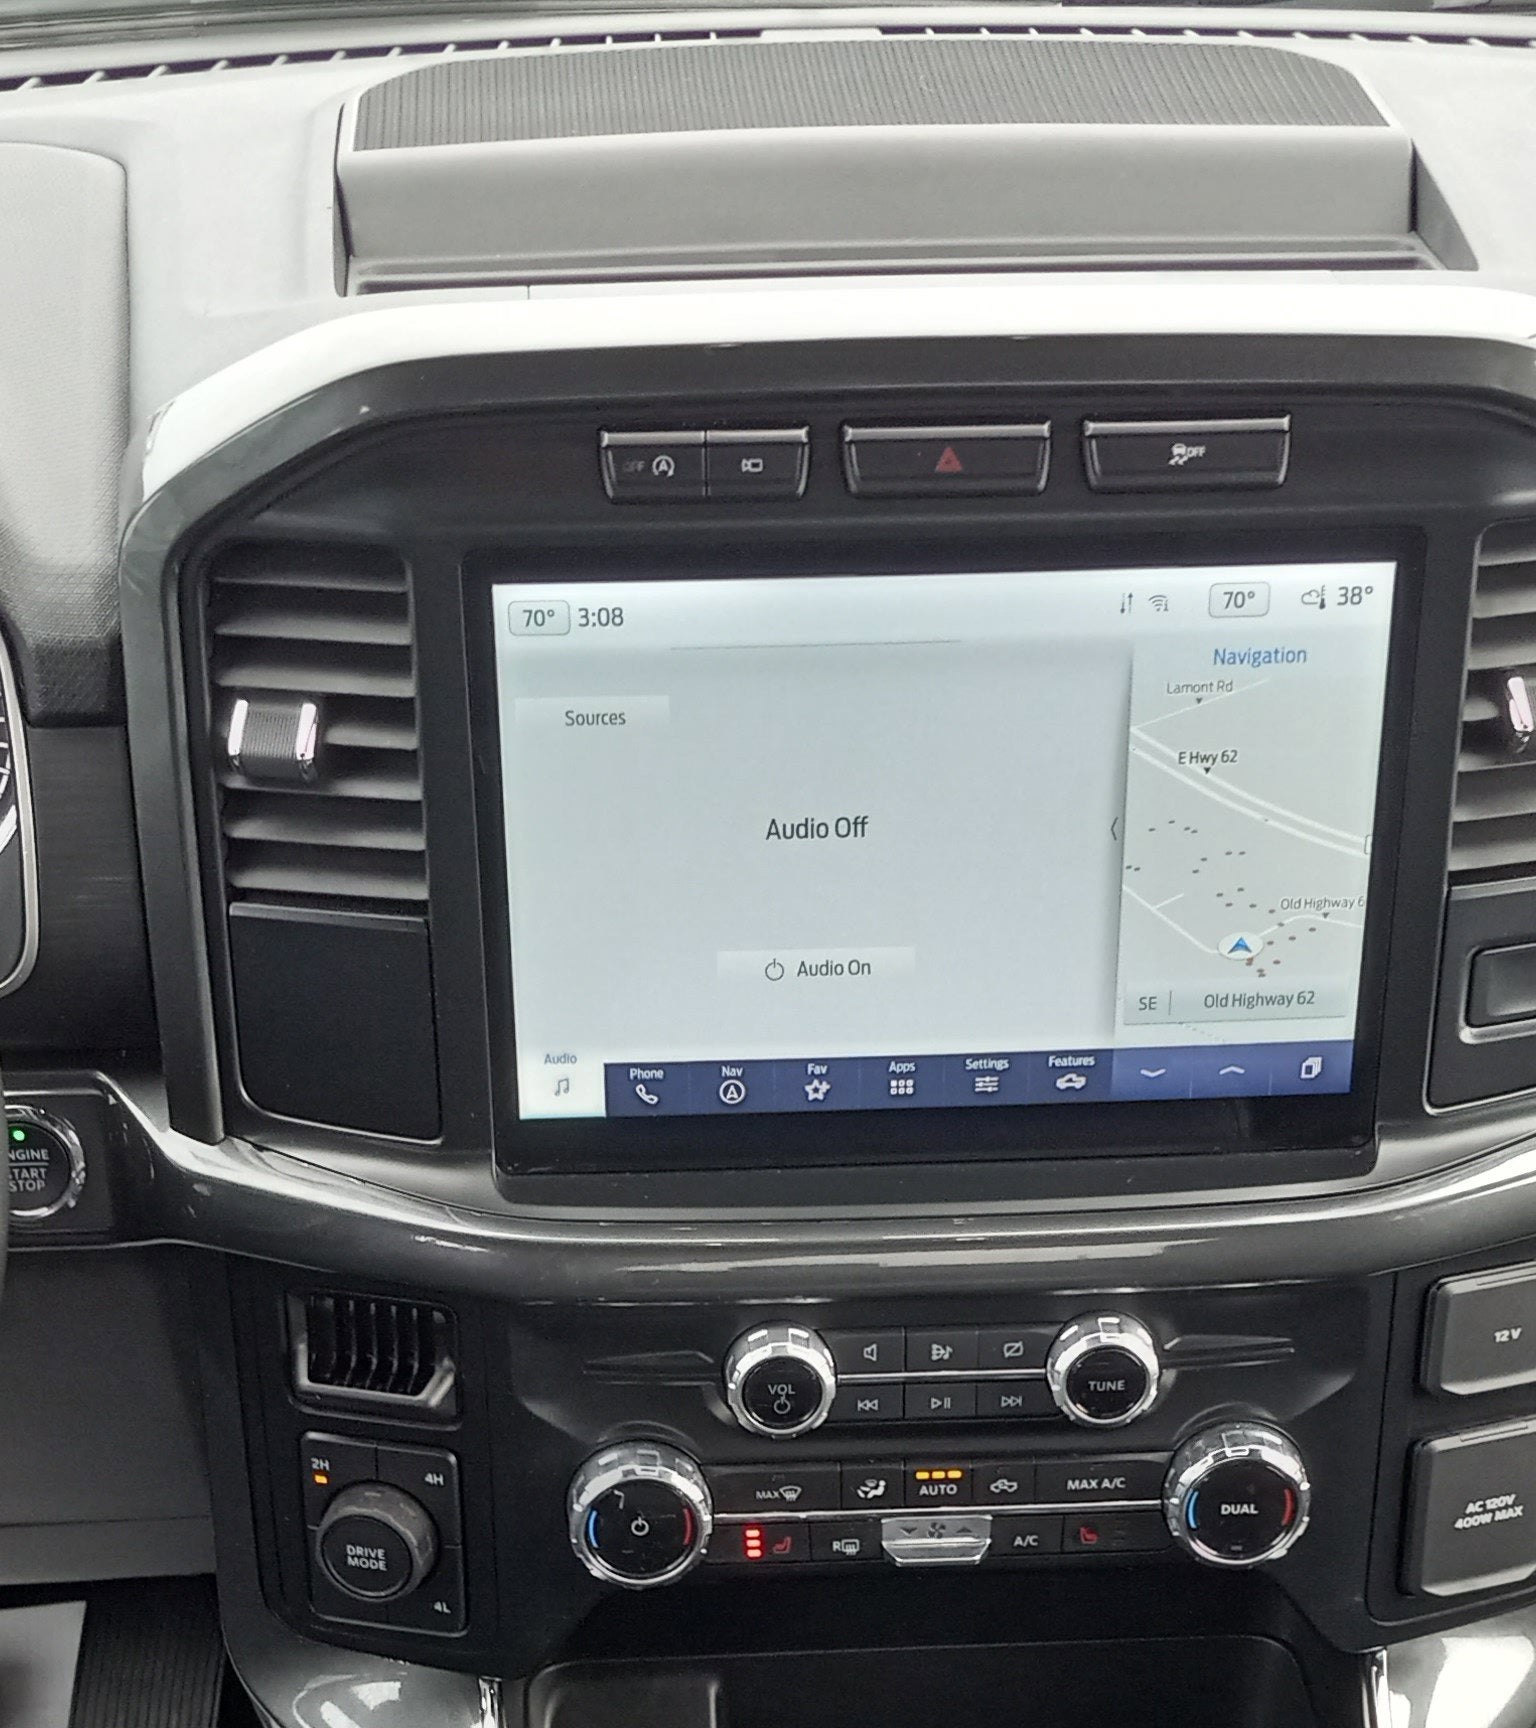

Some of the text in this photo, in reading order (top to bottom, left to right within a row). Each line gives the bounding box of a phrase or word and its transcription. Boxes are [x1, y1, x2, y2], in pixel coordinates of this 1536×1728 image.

[1222, 585, 1374, 610] 70° 38°
[522, 606, 624, 628] 70° 3:08
[1213, 647, 1308, 669] Navigation
[1167, 679, 1234, 695] Lamont Rd
[564, 709, 626, 727] Sources
[1178, 750, 1238, 768] E Hwy 62
[765, 815, 870, 841] Audio Off
[1280, 898, 1302, 911] Old
[1303, 896, 1356, 910] Highway
[796, 958, 872, 978] Audio On
[1138, 996, 1158, 1011] SE
[1203, 990, 1315, 1010] Old Highway 62
[544, 1052, 577, 1066] Audio
[965, 1057, 1010, 1072] Settings
[1048, 1054, 1096, 1068] Features
[628, 1067, 665, 1081] Phone
[720, 1065, 744, 1078] Nav
[807, 1062, 829, 1076] Fav
[888, 1060, 916, 1075] Apps
[9, 1149, 50, 1161] NGINE
[767, 1383, 796, 1396] VOL
[1088, 1379, 1126, 1392] TUNE
[310, 1457, 330, 1471] 2H
[424, 1472, 445, 1486] 4H
[1066, 1476, 1126, 1492] MAX A/C
[755, 1488, 780, 1501] MAX
[918, 1483, 958, 1497] AUTO
[1220, 1502, 1259, 1516] DUAL
[1464, 1493, 1517, 1515] AC 120V
[1454, 1504, 1524, 1530] 400W MAX
[1013, 1533, 1039, 1548] A/C
[345, 1544, 385, 1560] DRIVE
[346, 1556, 387, 1571] MODE
[433, 1601, 451, 1614] 4L
